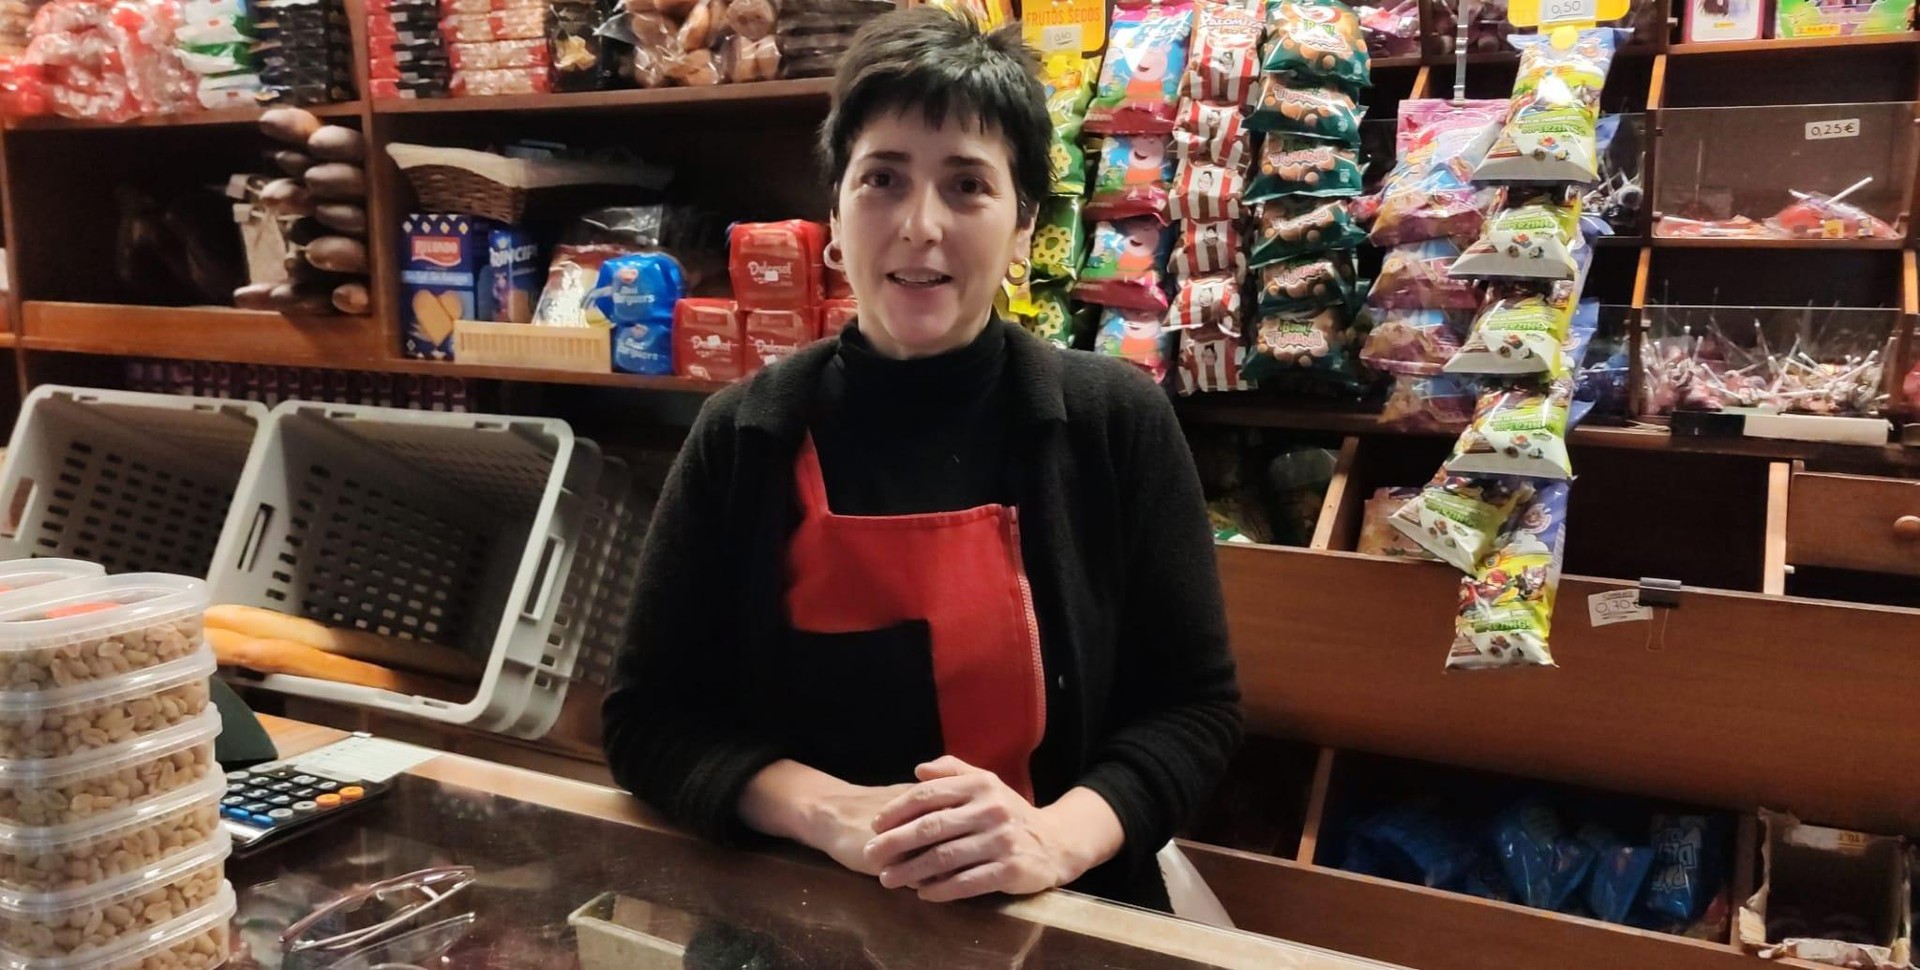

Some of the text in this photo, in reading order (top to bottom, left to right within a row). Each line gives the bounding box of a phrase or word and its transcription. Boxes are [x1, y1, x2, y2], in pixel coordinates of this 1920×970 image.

[1026, 7, 1100, 26] FRUTOS SECOS
[1810, 122, 1856, 137] 0,25€
